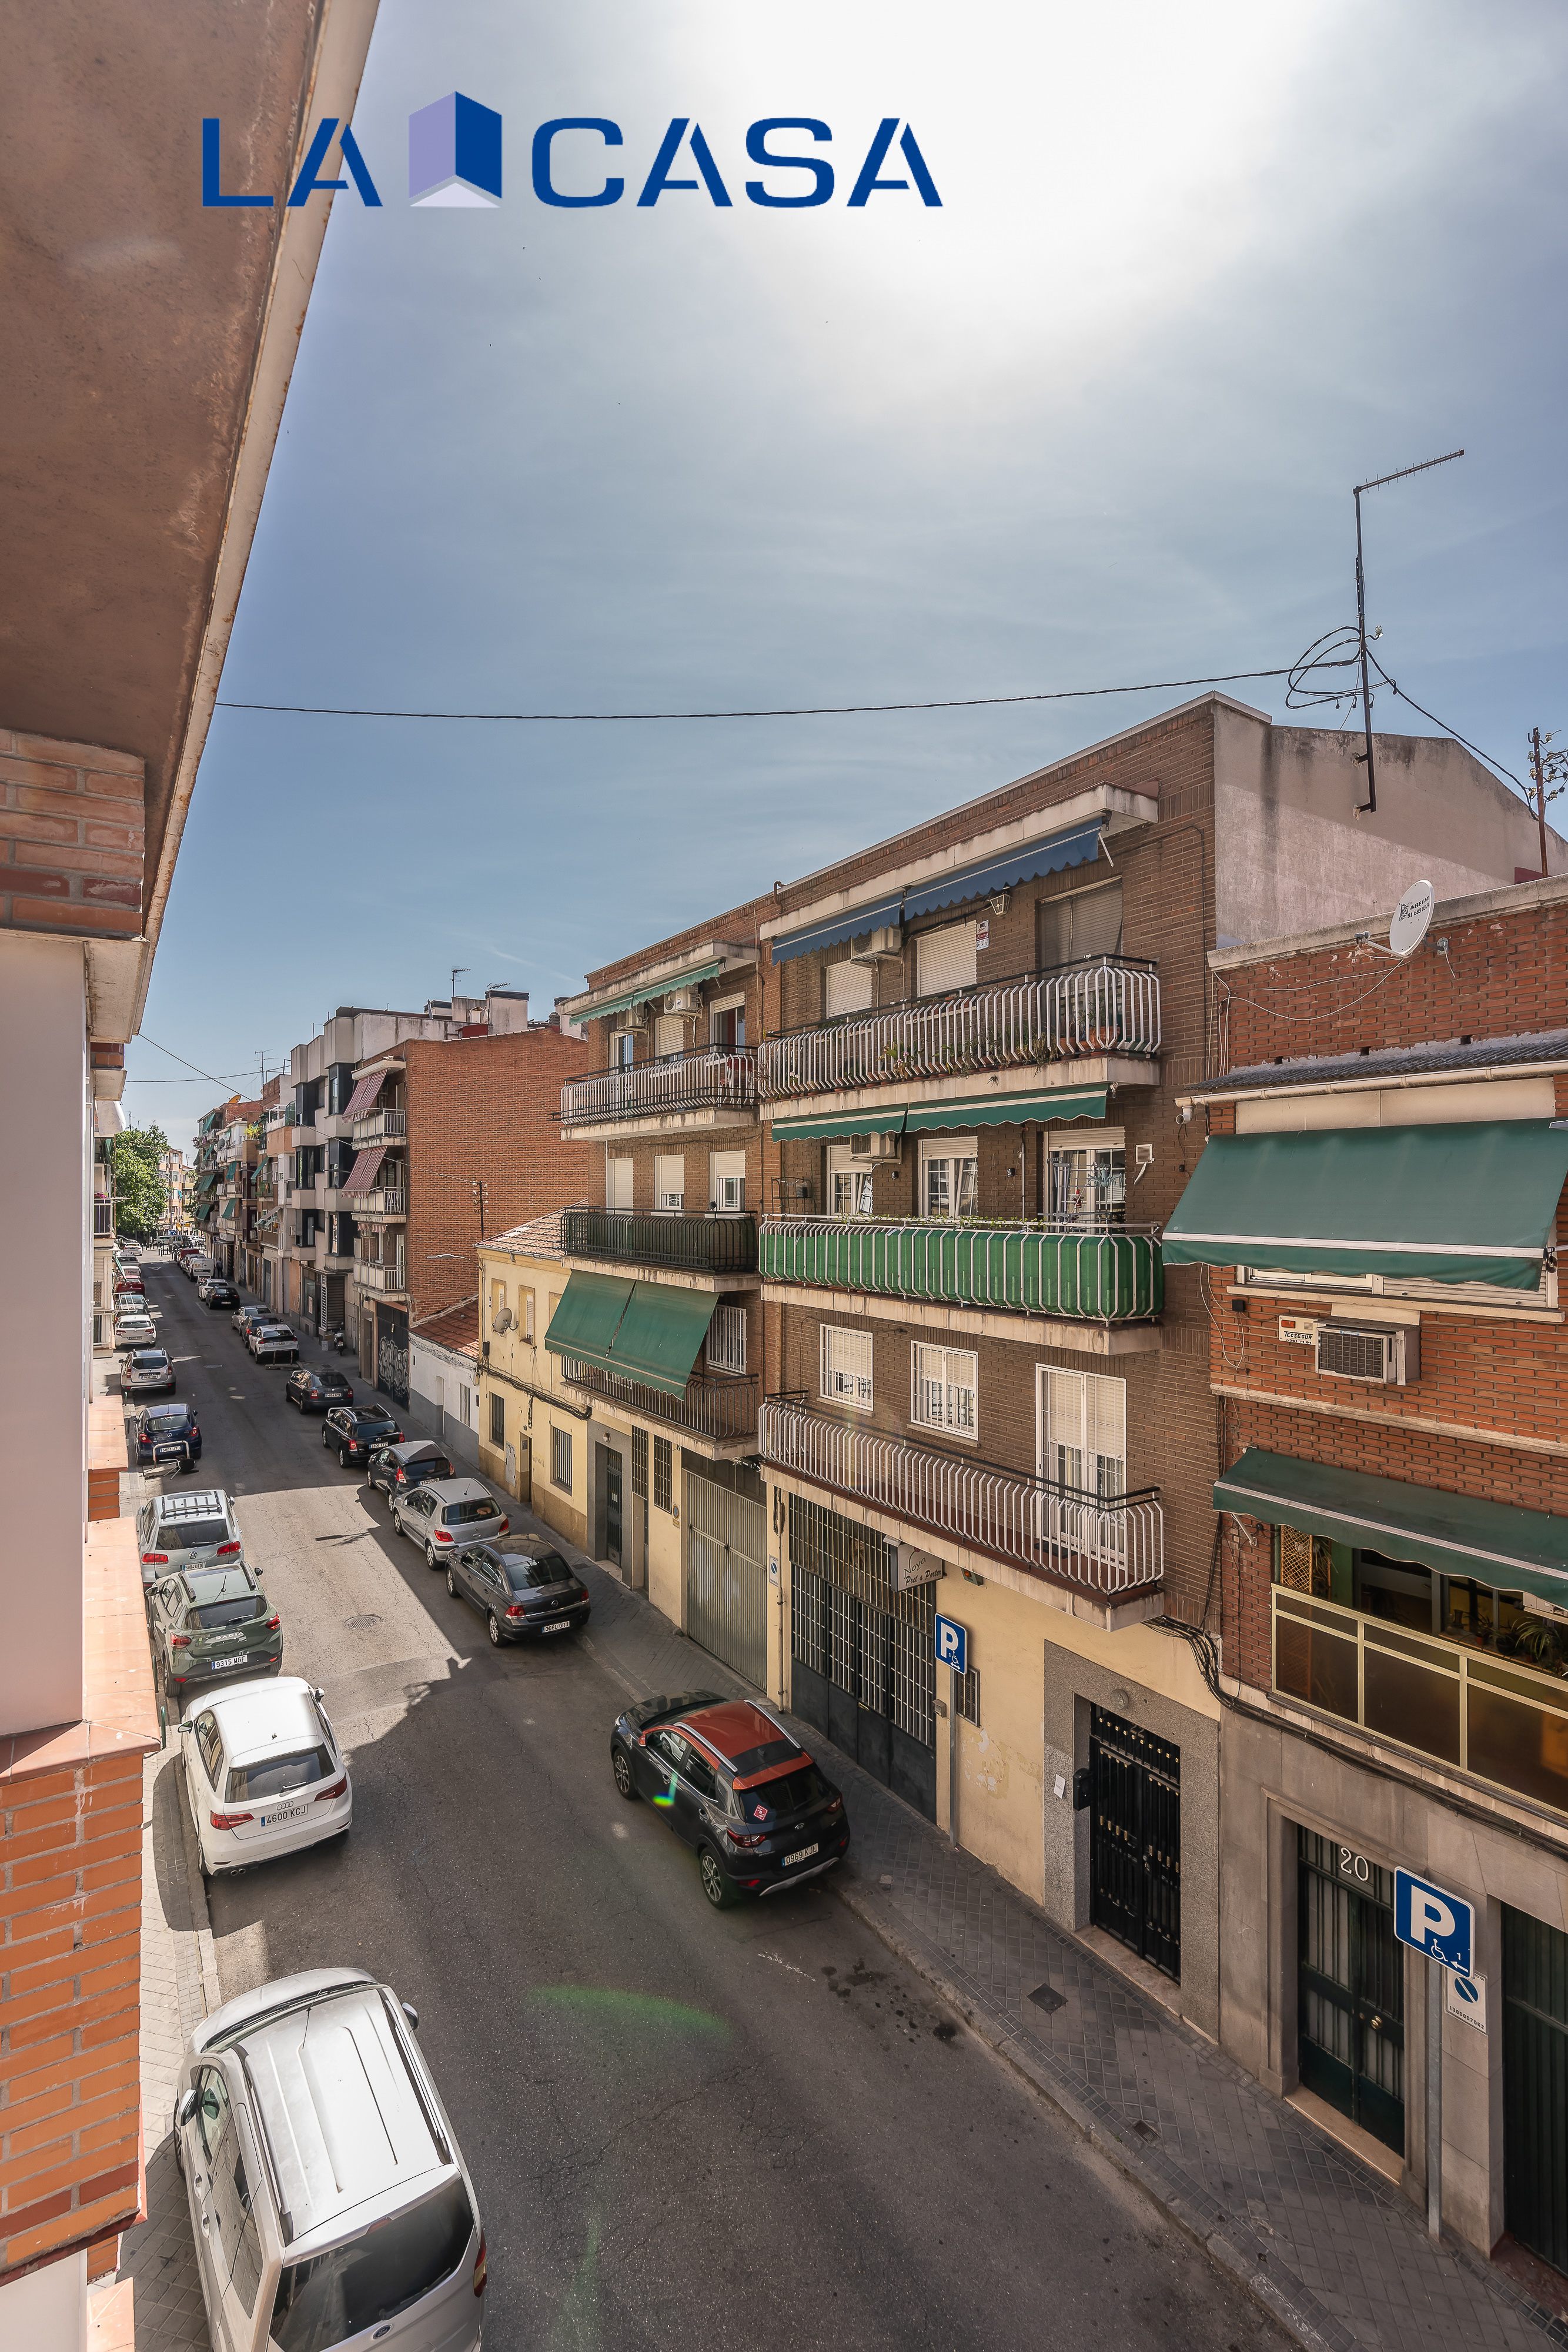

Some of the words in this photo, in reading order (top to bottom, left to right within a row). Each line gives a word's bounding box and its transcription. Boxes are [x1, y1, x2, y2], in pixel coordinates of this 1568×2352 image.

[1284, 1331, 1313, 1339] TECSEGUR
[941, 1622, 958, 1658] P
[267, 1812, 287, 1823] 4600
[290, 1806, 306, 1817] KCJ
[786, 1851, 803, 1864] 0969
[804, 1846, 817, 1857] KJL
[1341, 1847, 1369, 1881] 20
[1411, 1885, 1455, 1944] P
